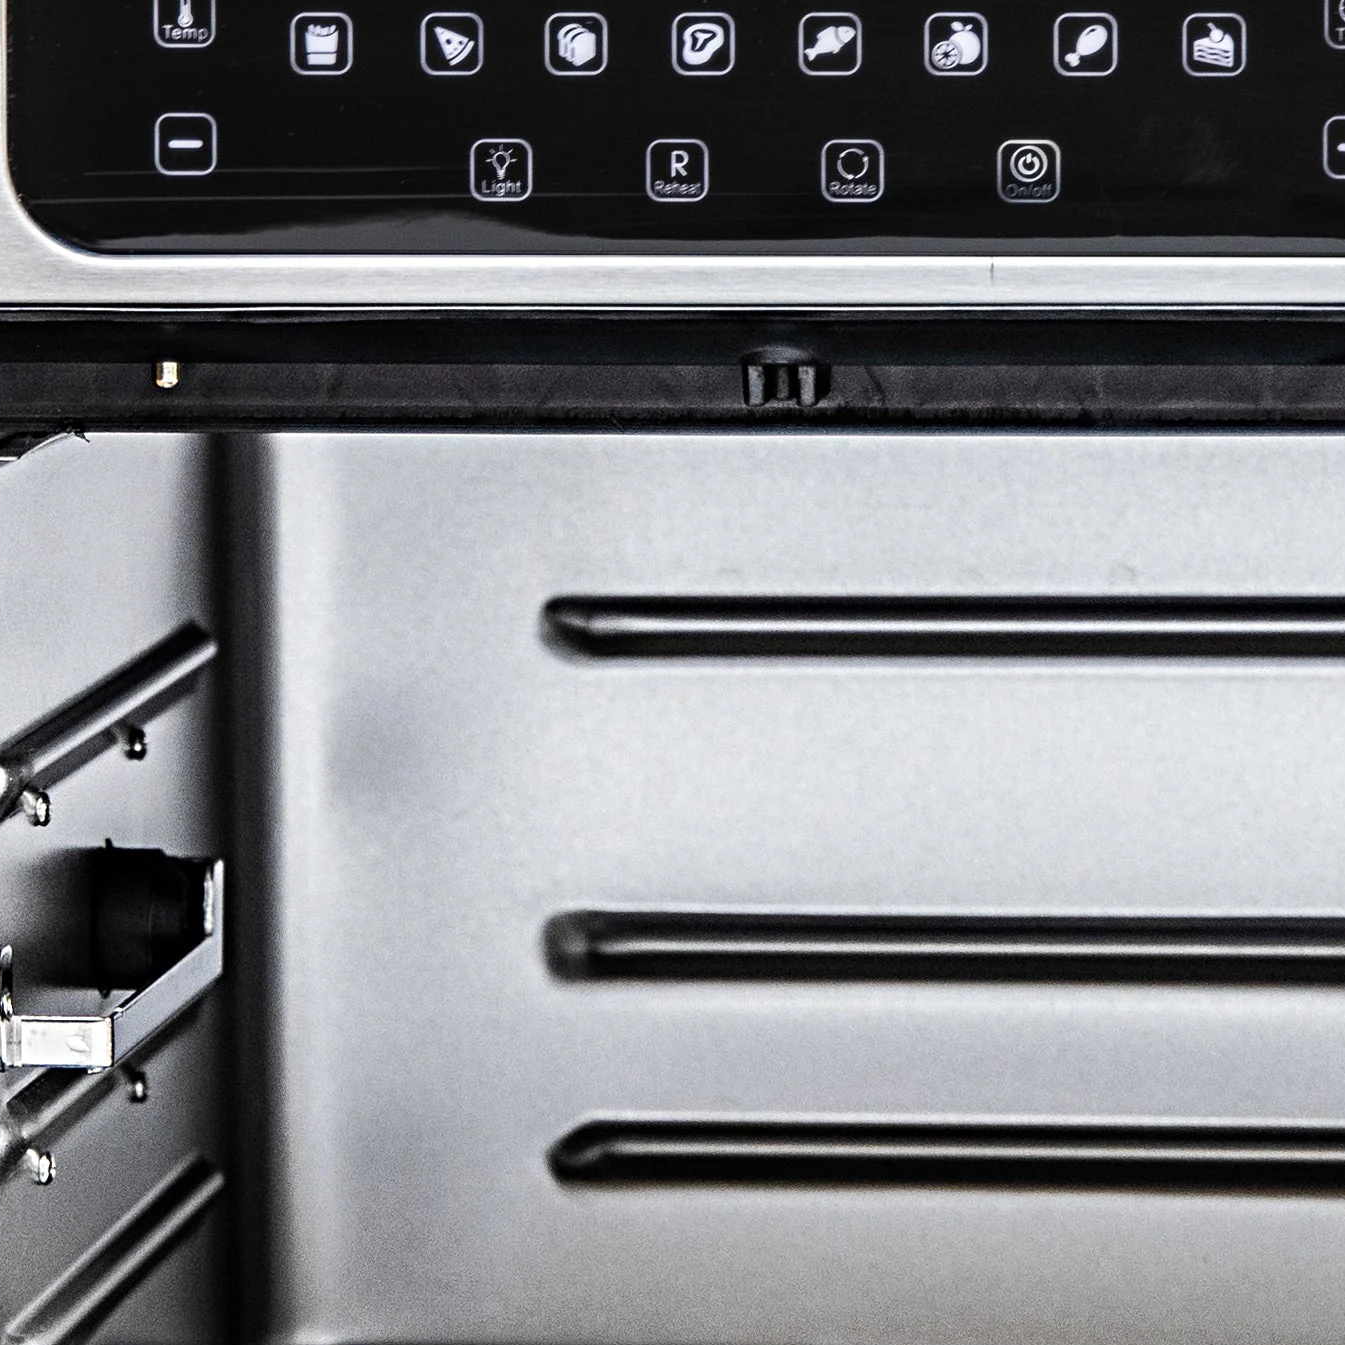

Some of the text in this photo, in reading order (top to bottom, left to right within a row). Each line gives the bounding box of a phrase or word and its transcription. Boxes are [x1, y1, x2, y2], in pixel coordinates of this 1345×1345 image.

[161, 24, 208, 43] Temp
[481, 178, 522, 197] Light
[653, 180, 702, 197] Reheat
[829, 181, 878, 197] Rotate
